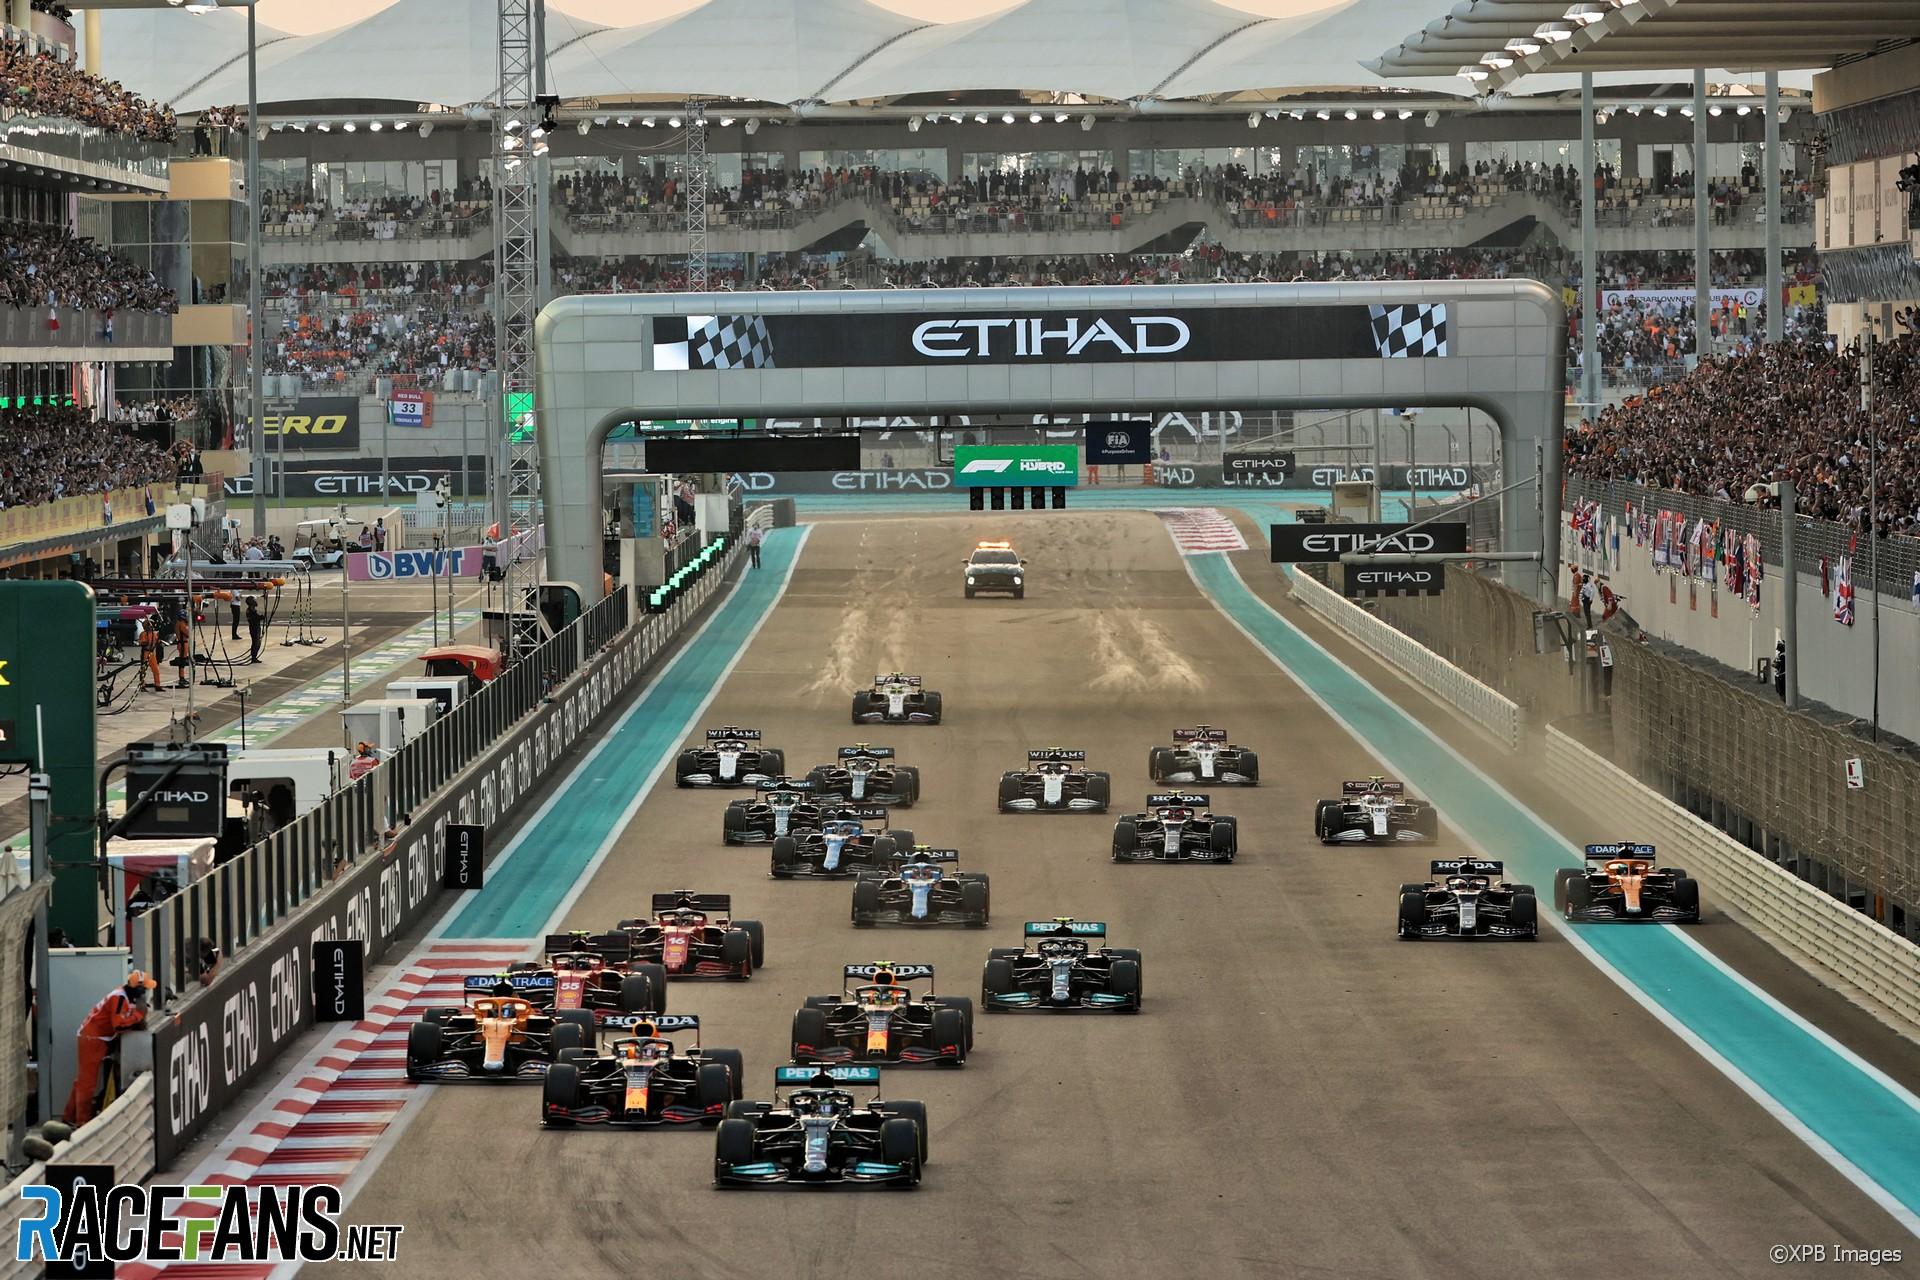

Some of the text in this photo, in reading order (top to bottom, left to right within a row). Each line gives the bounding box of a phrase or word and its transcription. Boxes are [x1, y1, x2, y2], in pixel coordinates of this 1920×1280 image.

[911, 317, 1191, 357] ETIHAD
[401, 402, 416, 413] 33
[248, 415, 347, 434] ERO
[1232, 459, 1287, 469] ETIHAD
[313, 474, 431, 494] ETIHAD
[831, 471, 951, 490] ETIHAD
[1406, 468, 1467, 486] ETIHAD
[1302, 532, 1435, 553] ETIHAD
[394, 550, 465, 577] BWT
[1356, 571, 1432, 583] ETIHAD
[460, 831, 469, 884] ETIHAD
[1437, 861, 1497, 870] HODA
[408, 833, 429, 910] ETIHAD
[380, 858, 402, 938] ETIHAD
[668, 936, 686, 945] 16
[334, 948, 345, 1015] ETIHAD
[561, 982, 580, 991] 55
[270, 944, 301, 1044] ETIHAD
[223, 981, 259, 1087] ETIHAD
[169, 1021, 210, 1136] ETIHAD
[785, 1067, 871, 1078] PETONAS
